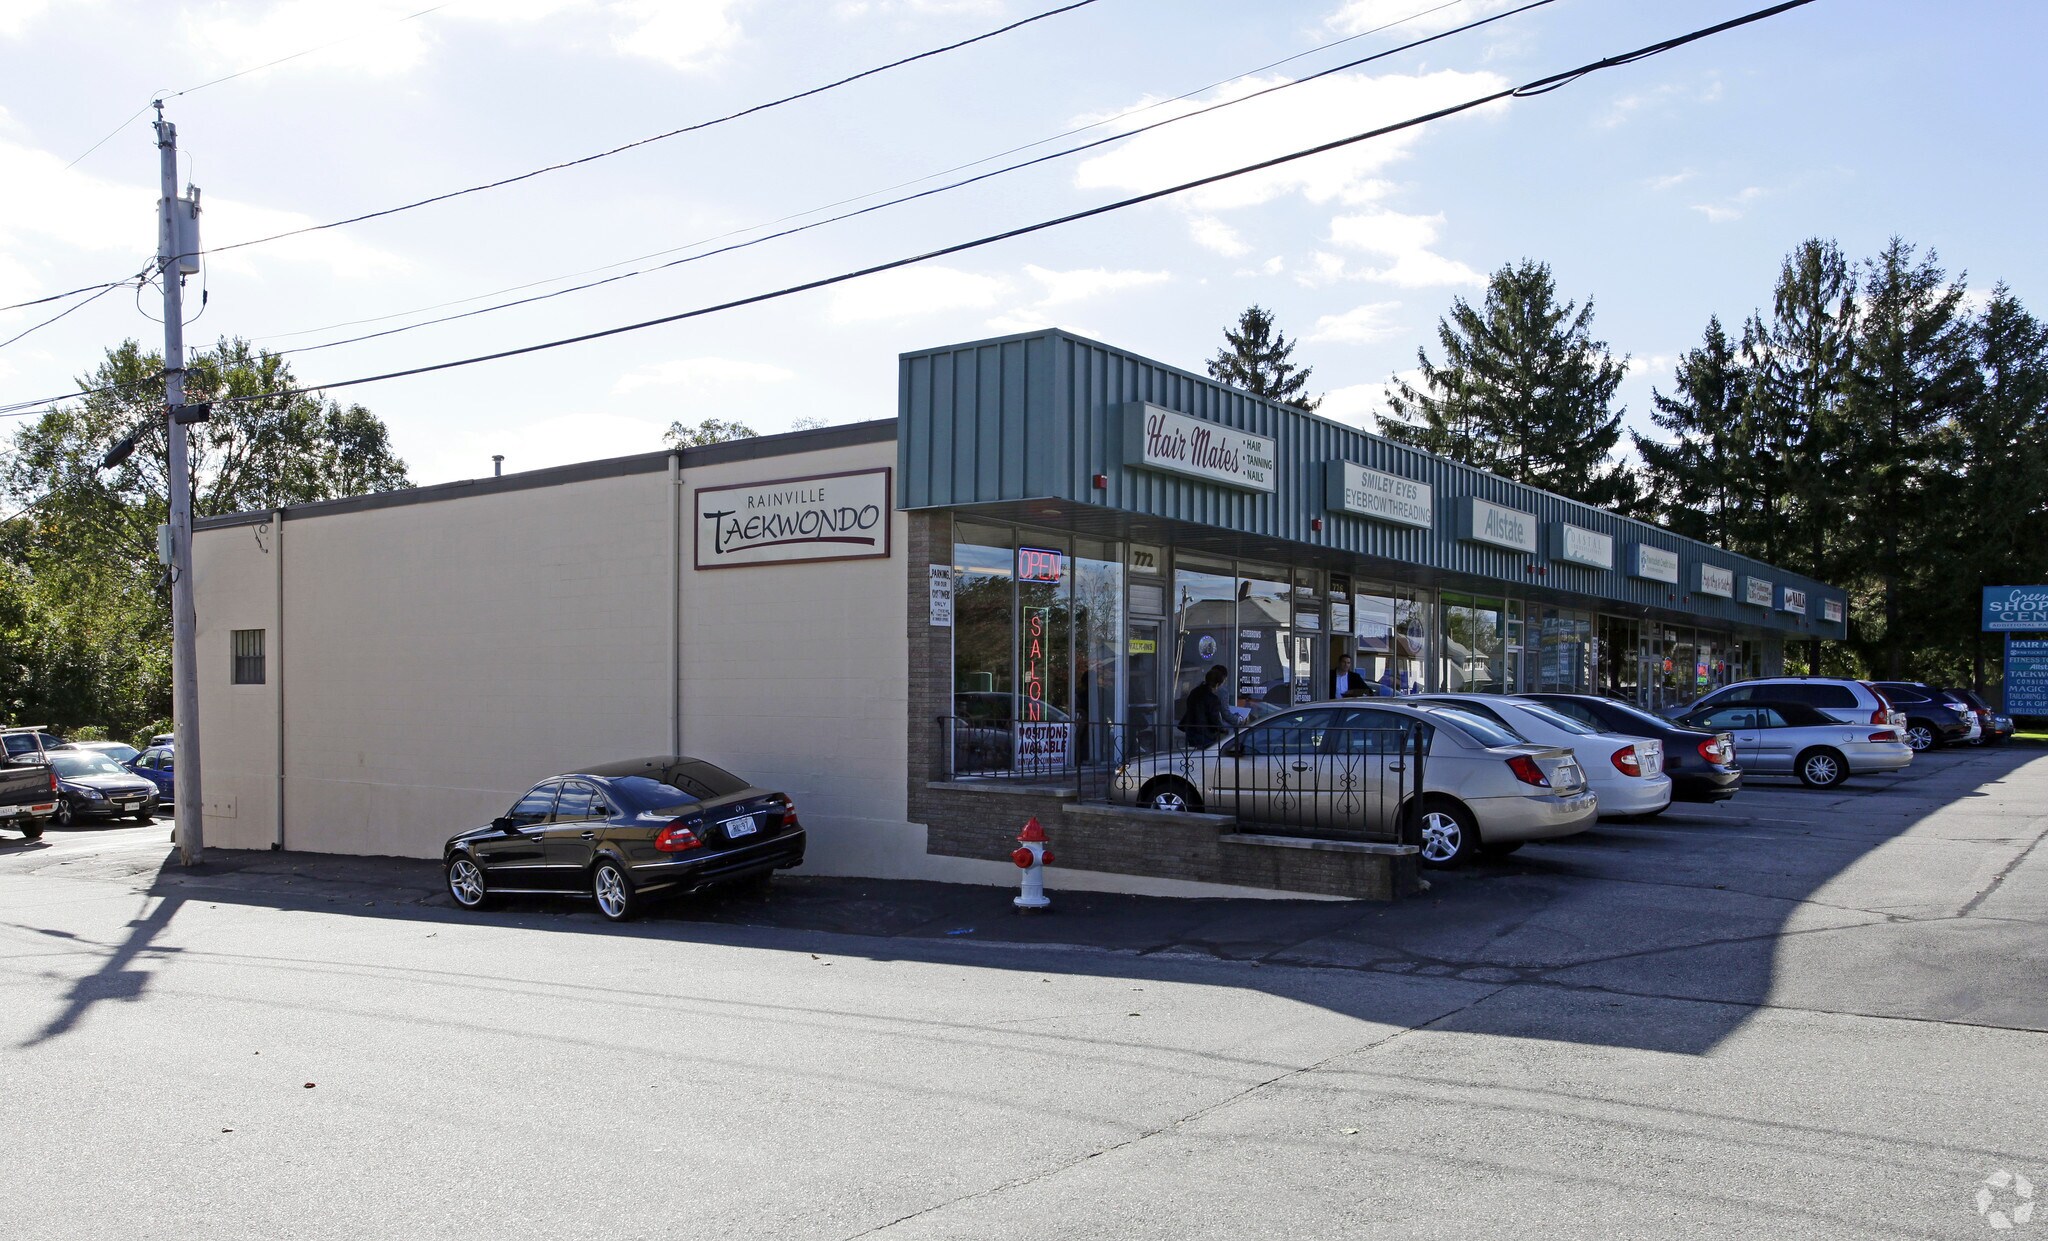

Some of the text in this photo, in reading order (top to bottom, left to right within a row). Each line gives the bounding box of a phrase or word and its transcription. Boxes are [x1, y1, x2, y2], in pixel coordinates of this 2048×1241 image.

[1147, 414, 1239, 474] Hair Mates
[1246, 439, 1261, 453] HAIR
[1246, 454, 1273, 470] TANNING
[1246, 469, 1264, 483] NAILS
[1361, 471, 1417, 500] SMILEY EYES
[747, 488, 825, 509] RAINVILLE
[1345, 487, 1431, 524] EYEBROW THREADING
[703, 504, 879, 554] TAEKWONDO
[1484, 508, 1524, 544] Allstate
[1020, 550, 1060, 580] OPEN
[1134, 551, 1154, 567] 772
[931, 569, 950, 579] PARKING
[1989, 601, 2048, 611] SHOP
[2000, 611, 2047, 622] CEN
[1029, 616, 1041, 722] SALON
[1018, 726, 1068, 740] POSITIONS
[1018, 741, 1067, 755] AVALABLE
